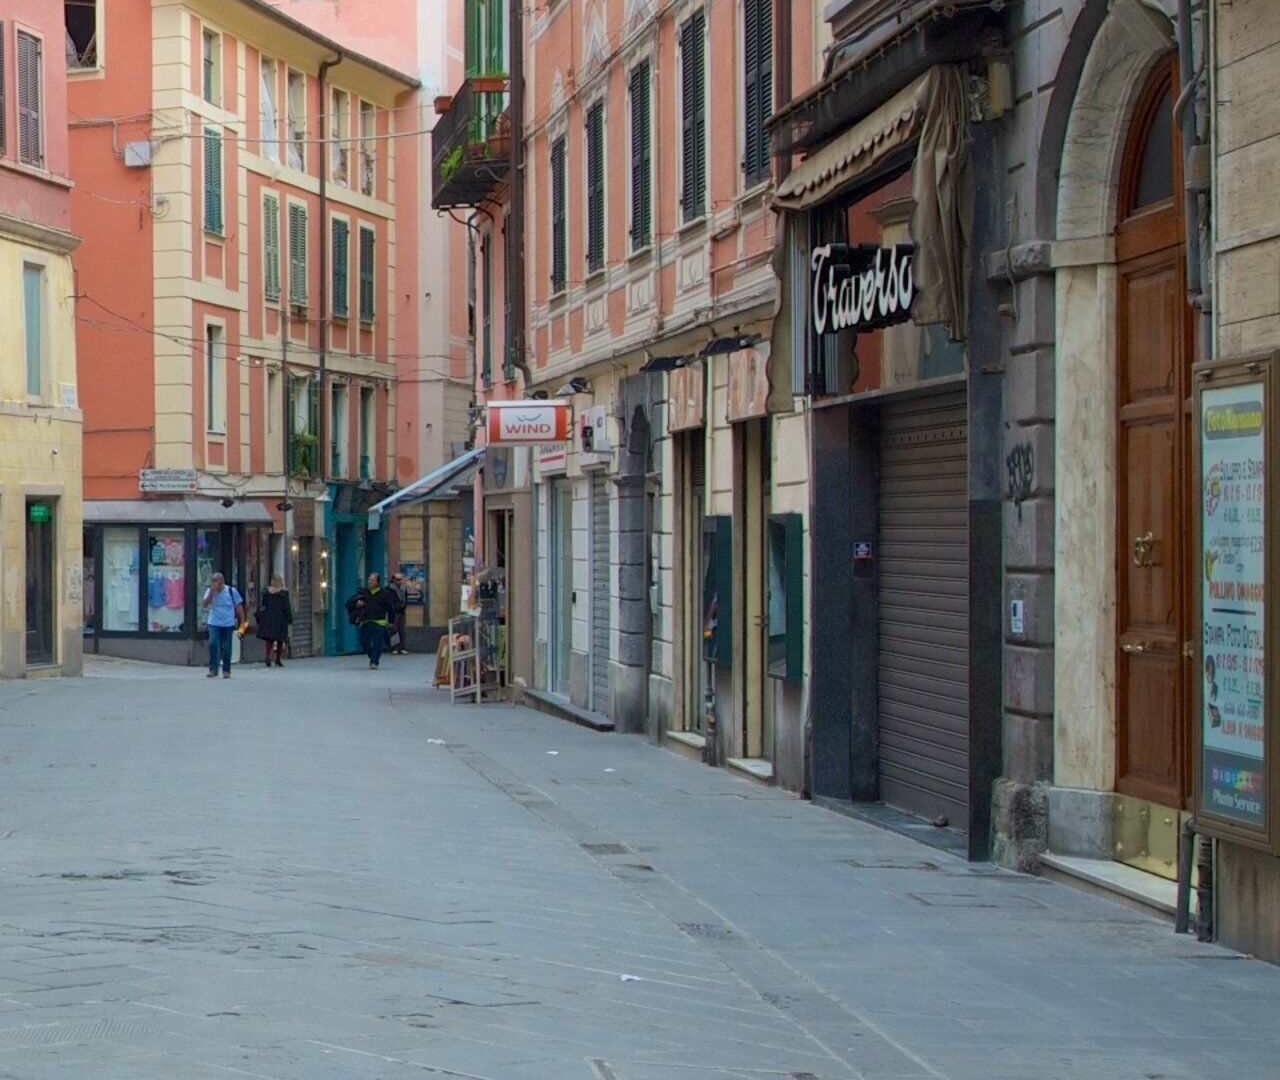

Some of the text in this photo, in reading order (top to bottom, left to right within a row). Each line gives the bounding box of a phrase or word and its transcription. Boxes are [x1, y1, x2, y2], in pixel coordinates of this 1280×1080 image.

[811, 243, 913, 335] Traverso
[505, 423, 552, 434] WIND
[1212, 788, 1261, 815] Photo Service
